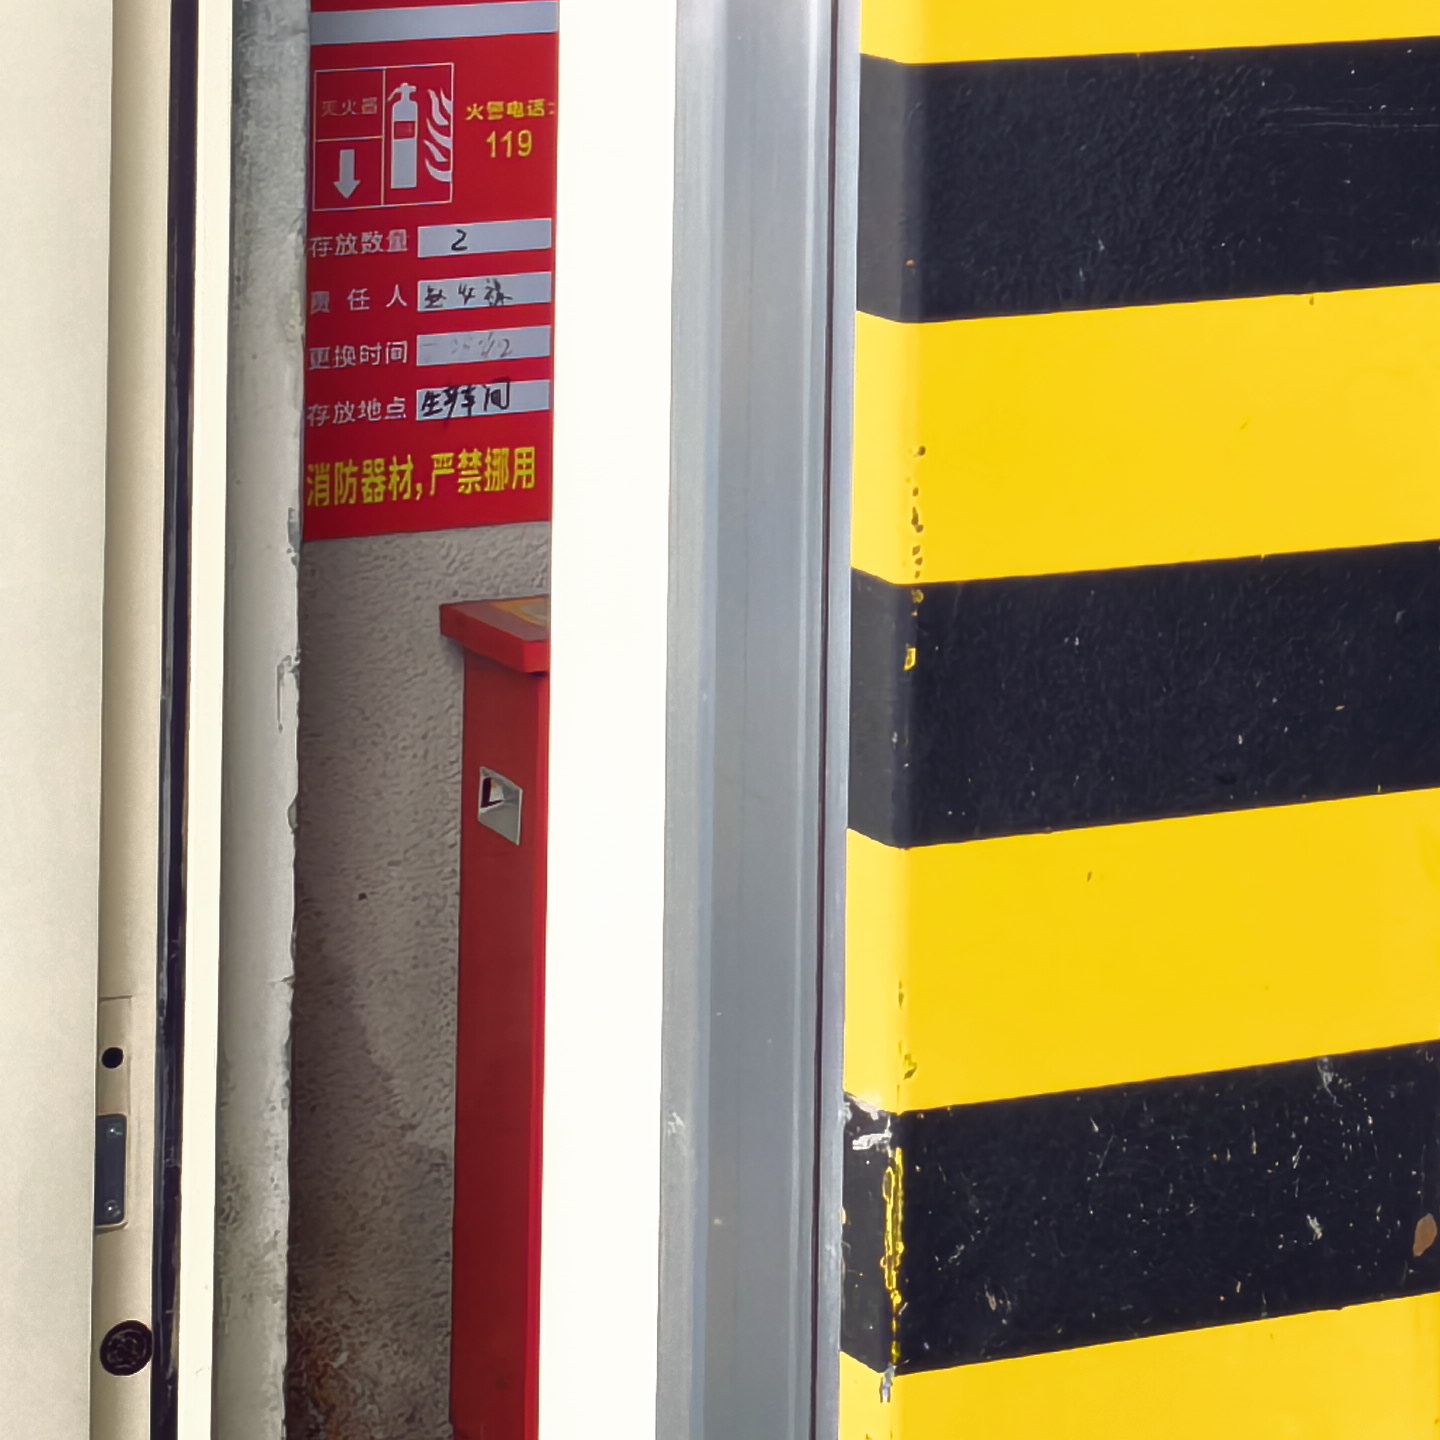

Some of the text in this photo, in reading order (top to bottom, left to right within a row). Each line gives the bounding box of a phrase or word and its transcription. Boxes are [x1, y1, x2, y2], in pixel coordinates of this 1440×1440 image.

[321, 96, 379, 118] 灭火器
[487, 129, 533, 158] 119
[309, 228, 468, 259] 存放数量 2
[309, 340, 408, 370] 更换时间
[307, 396, 408, 428] 存放地点
